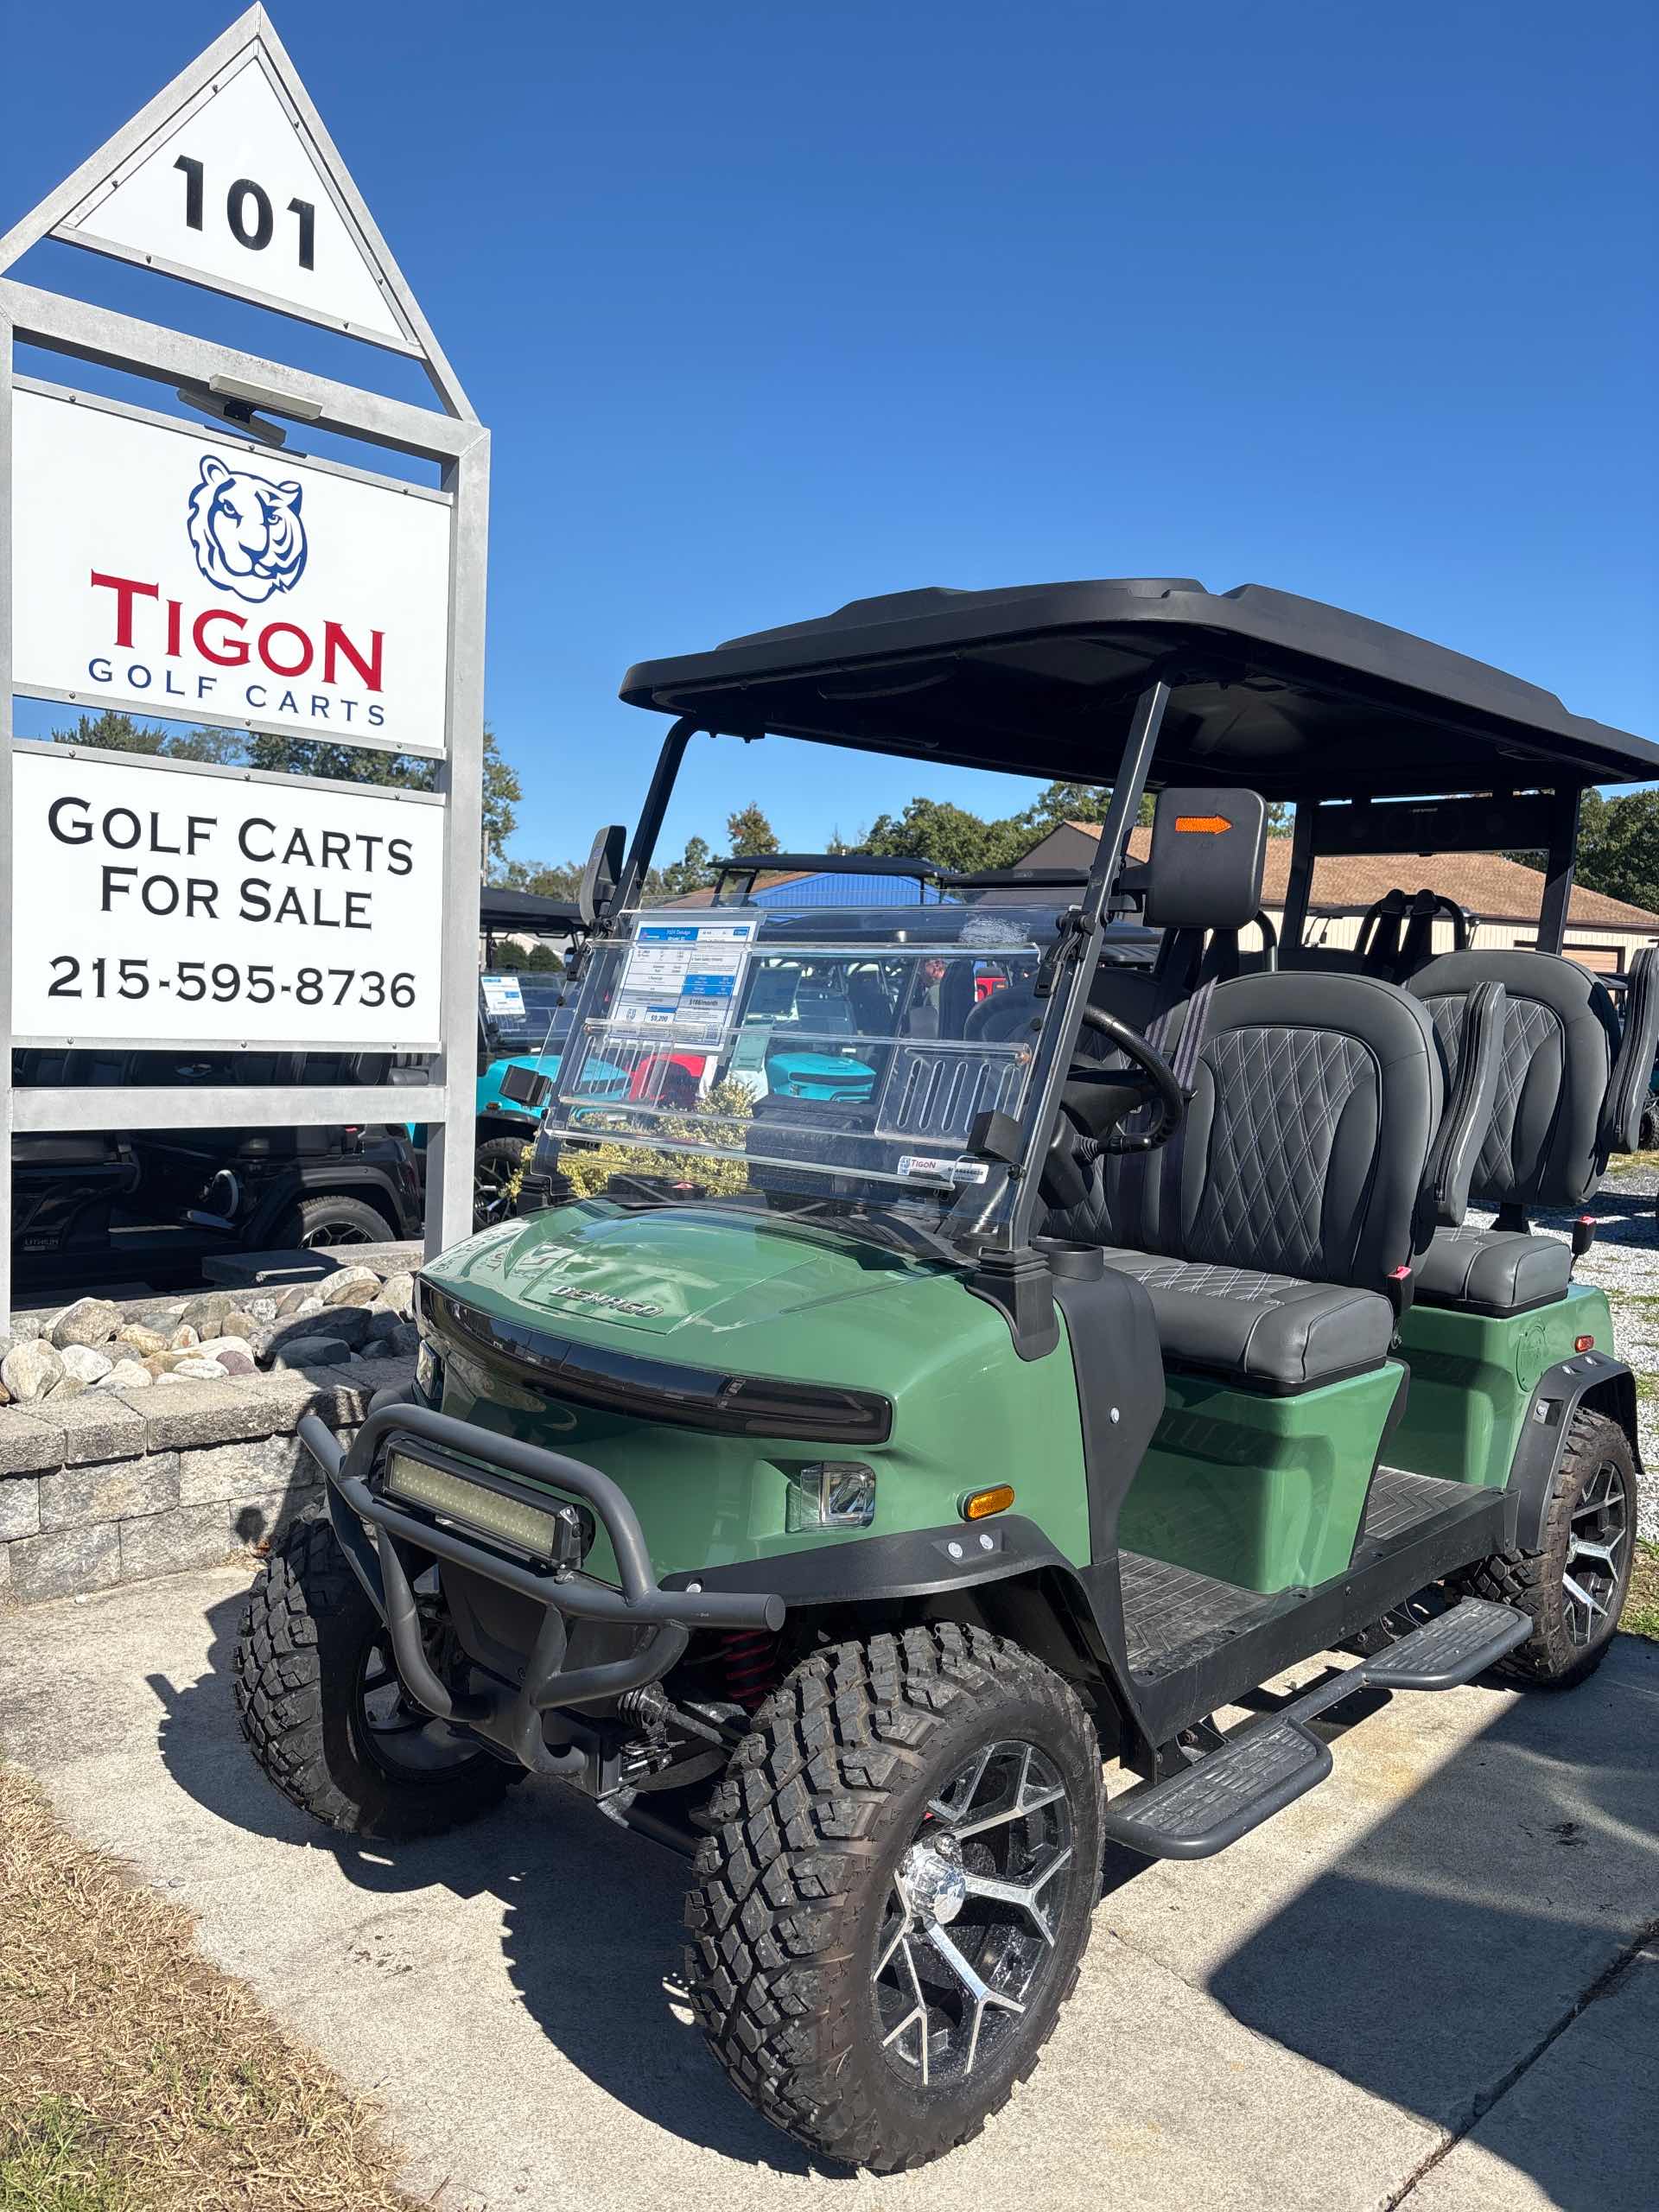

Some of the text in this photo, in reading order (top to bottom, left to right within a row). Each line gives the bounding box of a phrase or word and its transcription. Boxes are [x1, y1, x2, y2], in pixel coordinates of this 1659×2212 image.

[172, 155, 315, 271] 101
[90, 568, 385, 693] TIGON
[88, 658, 385, 727] GOLF CARTS
[48, 796, 414, 876] GOLF CARTS
[100, 865, 373, 931] FOR SALE
[48, 955, 416, 1009] 215-595-8736
[911, 1159, 937, 1169] TIGON
[549, 1285, 664, 1318] DENAGO
